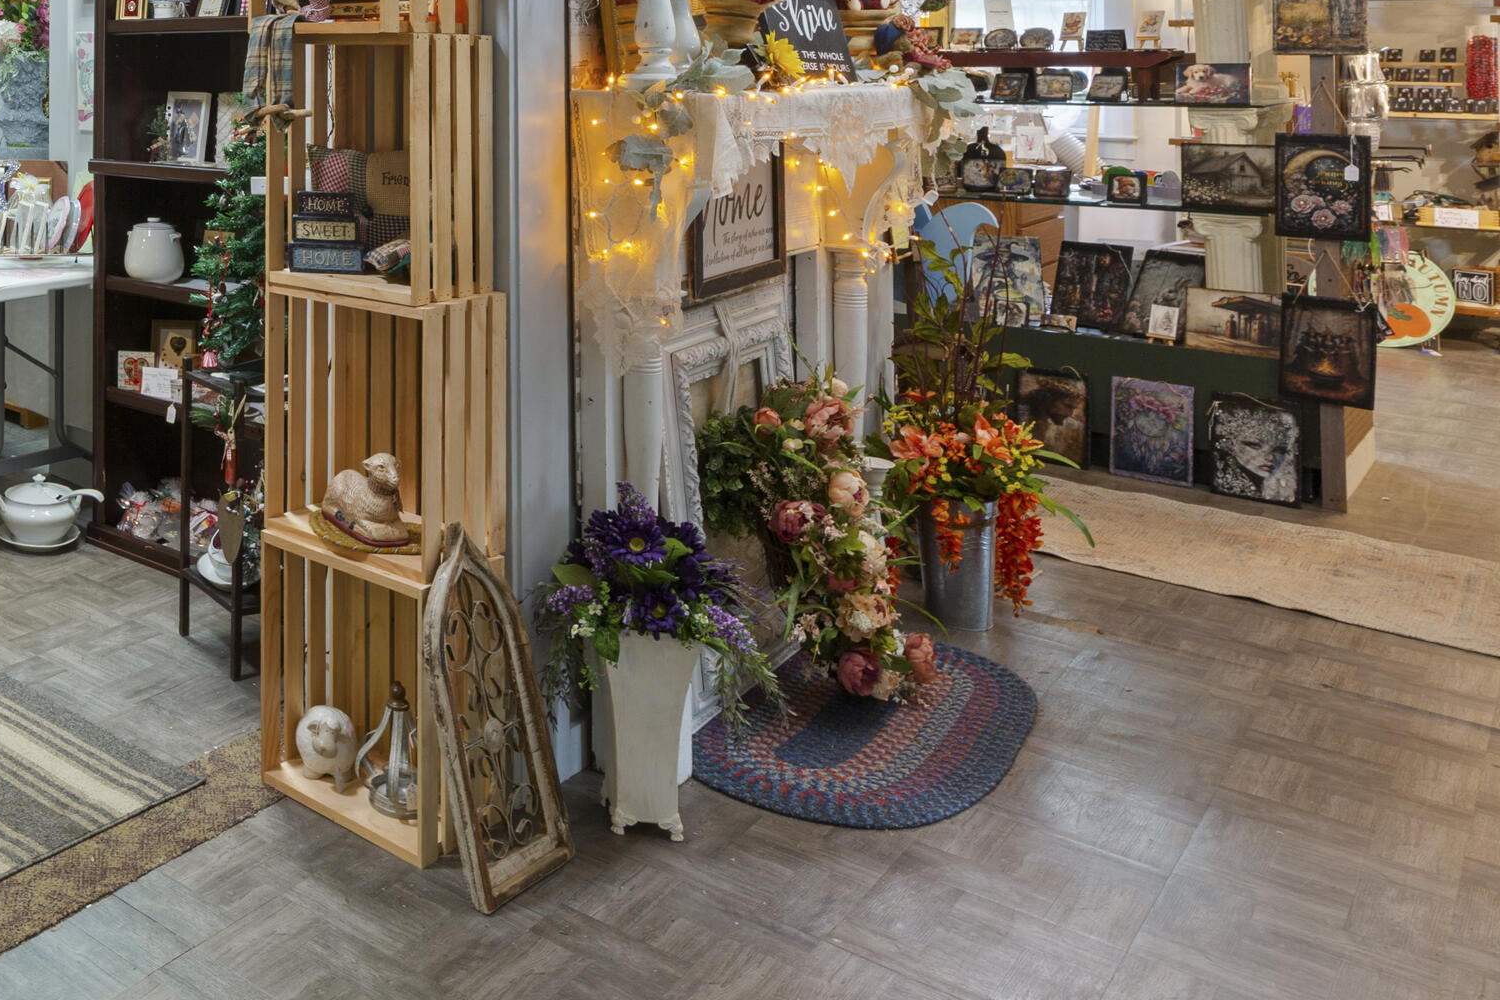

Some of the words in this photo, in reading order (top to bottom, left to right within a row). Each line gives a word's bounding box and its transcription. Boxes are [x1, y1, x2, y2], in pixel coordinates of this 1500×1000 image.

[801, 51, 817, 60] THE
[818, 51, 845, 61] WHOLE
[801, 61, 819, 71] ERSE
[820, 62, 826, 71] IS
[381, 171, 410, 187] Frien
[307, 198, 345, 211] HOME
[302, 223, 348, 238] SWEET
[302, 249, 353, 267] HOME
[1458, 281, 1487, 301] NO
